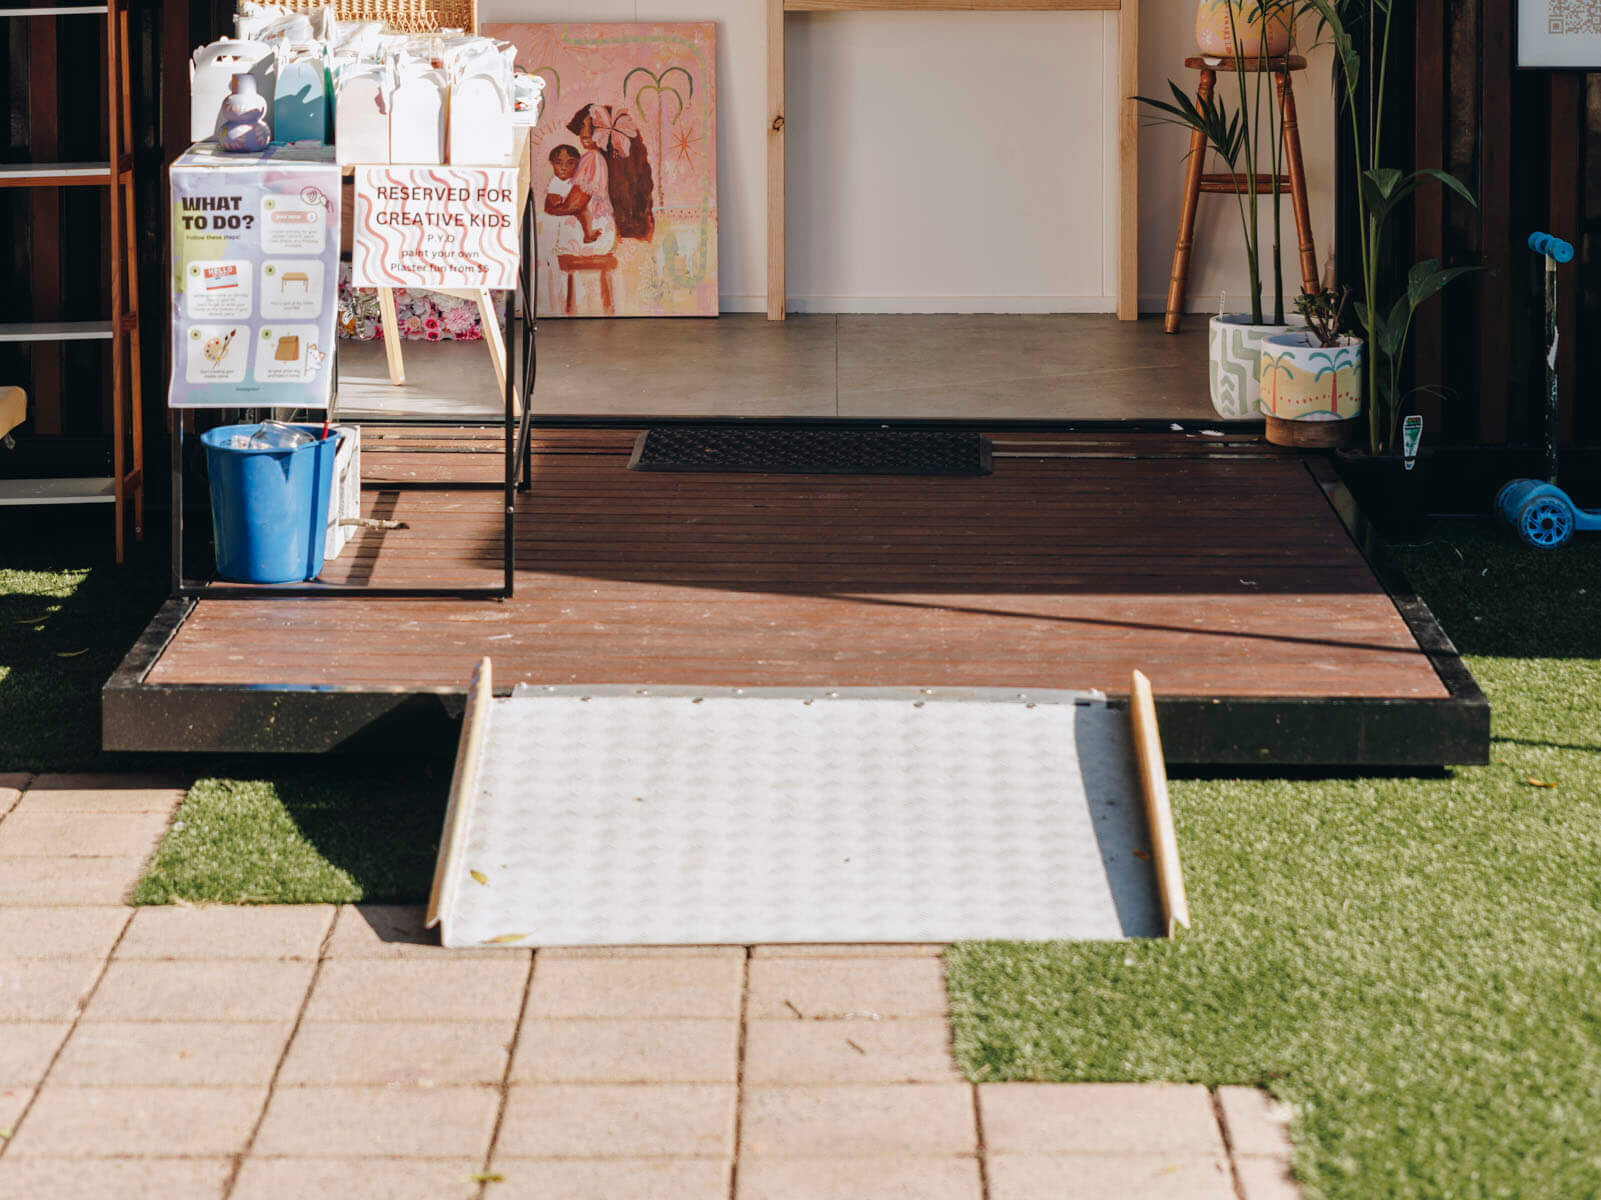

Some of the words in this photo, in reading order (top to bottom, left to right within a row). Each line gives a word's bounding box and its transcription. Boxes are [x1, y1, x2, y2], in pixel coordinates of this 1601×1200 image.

[377, 186, 470, 201] RESERVED
[477, 188, 512, 202] FOR
[182, 196, 242, 211] WHAT
[182, 215, 207, 230] TO
[213, 215, 255, 230] DO?
[376, 211, 465, 227] CREATIVE
[470, 213, 511, 228] KIDS
[401, 248, 428, 259] paint
[432, 250, 456, 259] your
[390, 262, 427, 272] Plaster
[428, 263, 447, 272] fun
[449, 263, 474, 272] from
